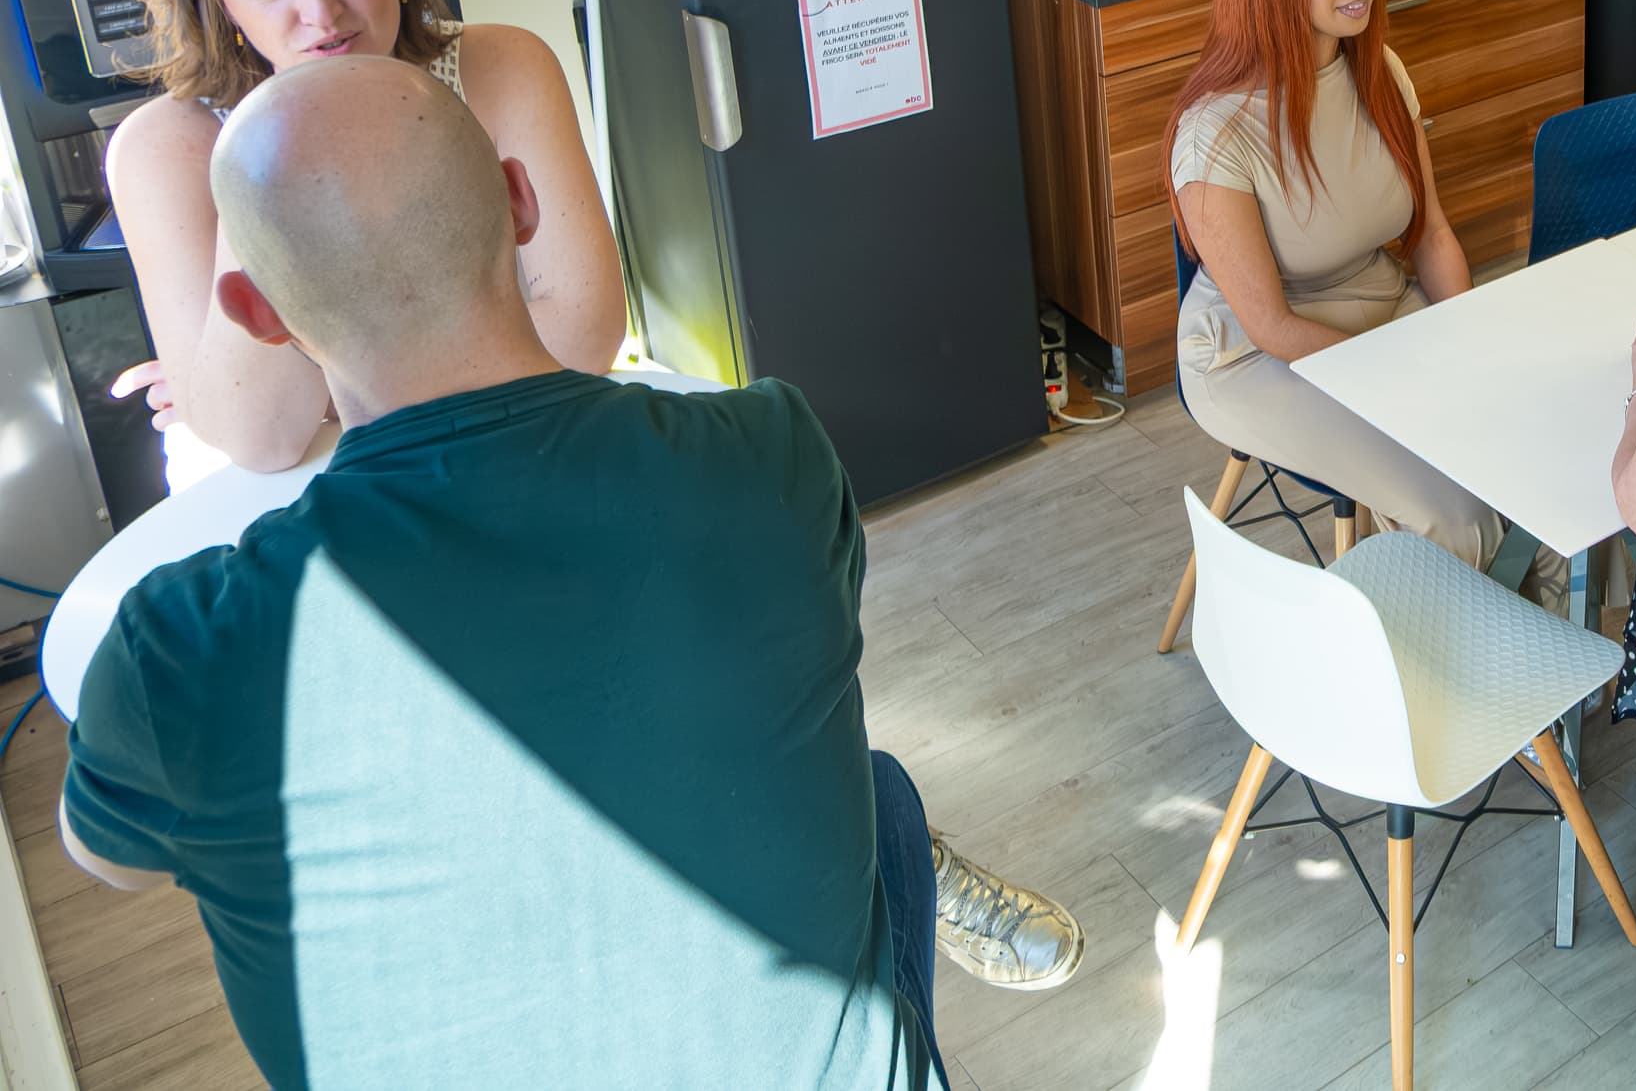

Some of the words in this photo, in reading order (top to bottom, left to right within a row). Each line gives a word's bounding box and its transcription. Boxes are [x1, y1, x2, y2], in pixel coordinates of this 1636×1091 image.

[816, 24, 850, 38] VEUILLEZ
[895, 11, 909, 20] VOS
[823, 32, 859, 46] ALIMENTS
[860, 30, 869, 38] ET
[870, 22, 905, 35] BOISSONS
[821, 56, 844, 66] FRIGO
[845, 51, 864, 60] SERA
[865, 39, 911, 55] TOTALEMENT
[822, 45, 847, 57] AVANT
[849, 42, 859, 50] CE
[900, 30, 908, 38] LE
[859, 56, 877, 67] VIDÉ
